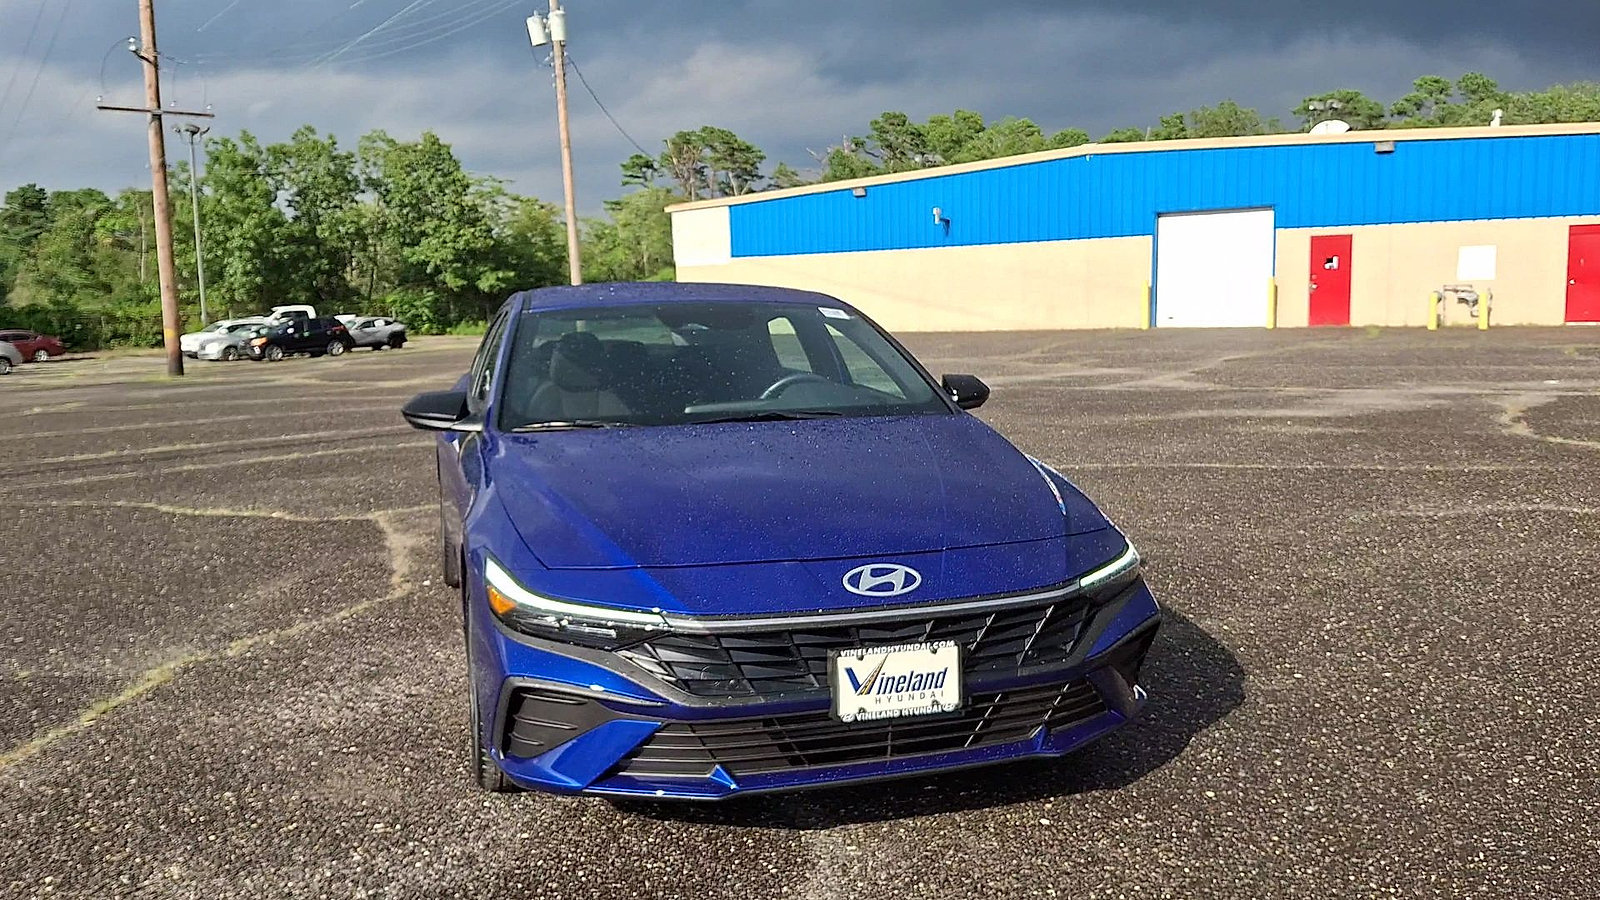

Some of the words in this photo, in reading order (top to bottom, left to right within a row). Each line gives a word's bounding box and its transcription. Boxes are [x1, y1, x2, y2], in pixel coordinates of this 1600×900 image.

[840, 640, 955, 657] VINELANDHYUNDAI.COM
[845, 657, 948, 696] Vineland
[875, 691, 944, 704] HYUNDAI
[856, 708, 900, 722] VINELAND
[902, 704, 942, 717] HYUNDAI
